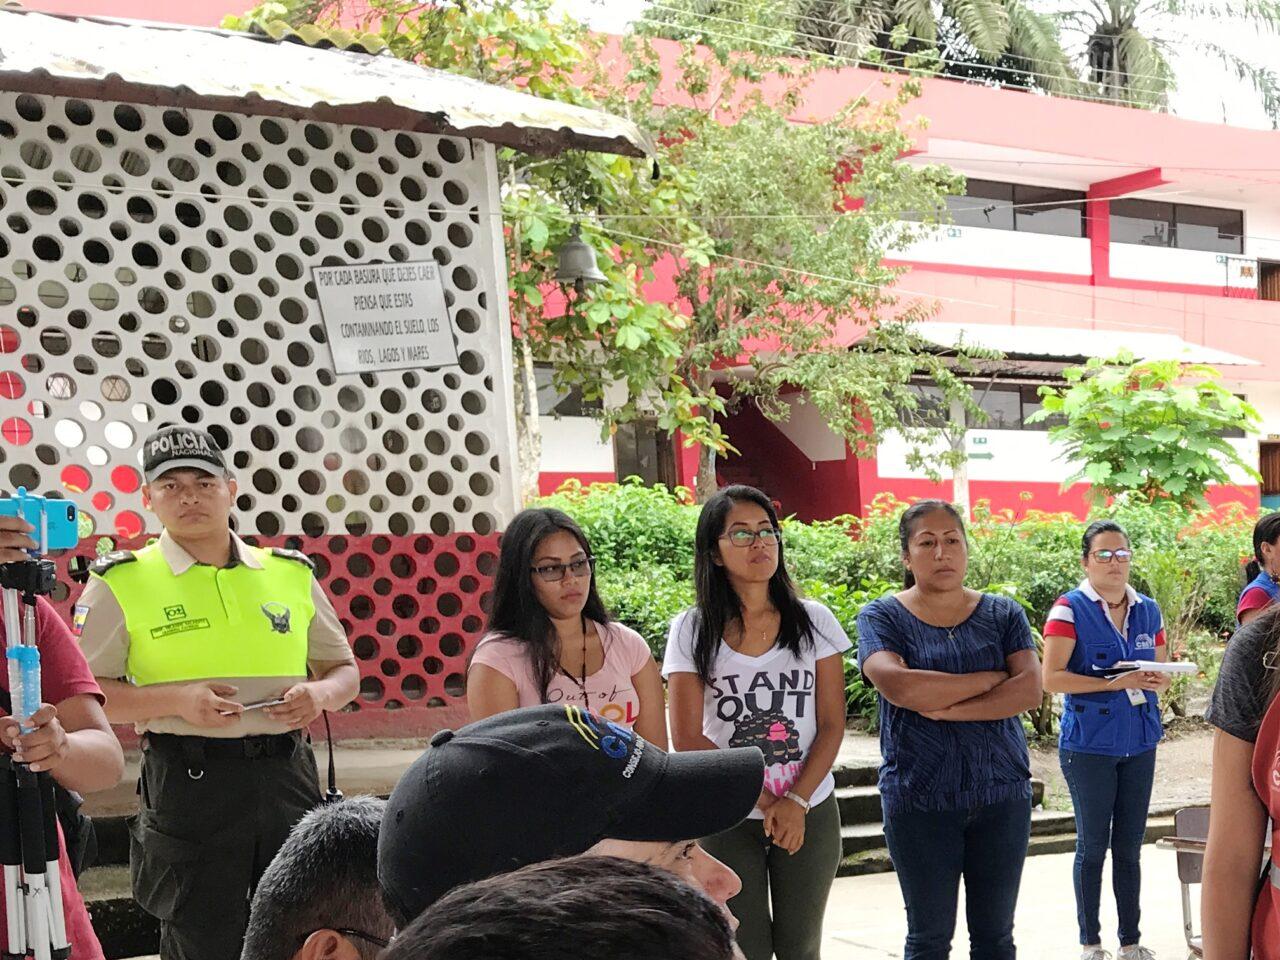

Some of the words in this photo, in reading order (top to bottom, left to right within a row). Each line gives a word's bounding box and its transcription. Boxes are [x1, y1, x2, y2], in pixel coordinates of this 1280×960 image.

[319, 271, 333, 286] POR
[334, 269, 353, 286] CADA
[353, 267, 381, 285] BASURA
[382, 267, 396, 285] QUE
[418, 265, 436, 281] CAER
[353, 293, 378, 310] PIENSA
[378, 294, 393, 311] QUE
[394, 292, 414, 308] ESTAS
[340, 319, 394, 338] CONTAMINANDO
[395, 319, 403, 335] EL
[427, 318, 440, 333] LOS
[378, 347, 400, 364] LAGOS
[400, 347, 406, 362] Y
[407, 345, 430, 361] MARES
[599, 684, 632, 703] of
[707, 669, 815, 699] STAND
[717, 690, 811, 722] OUT
